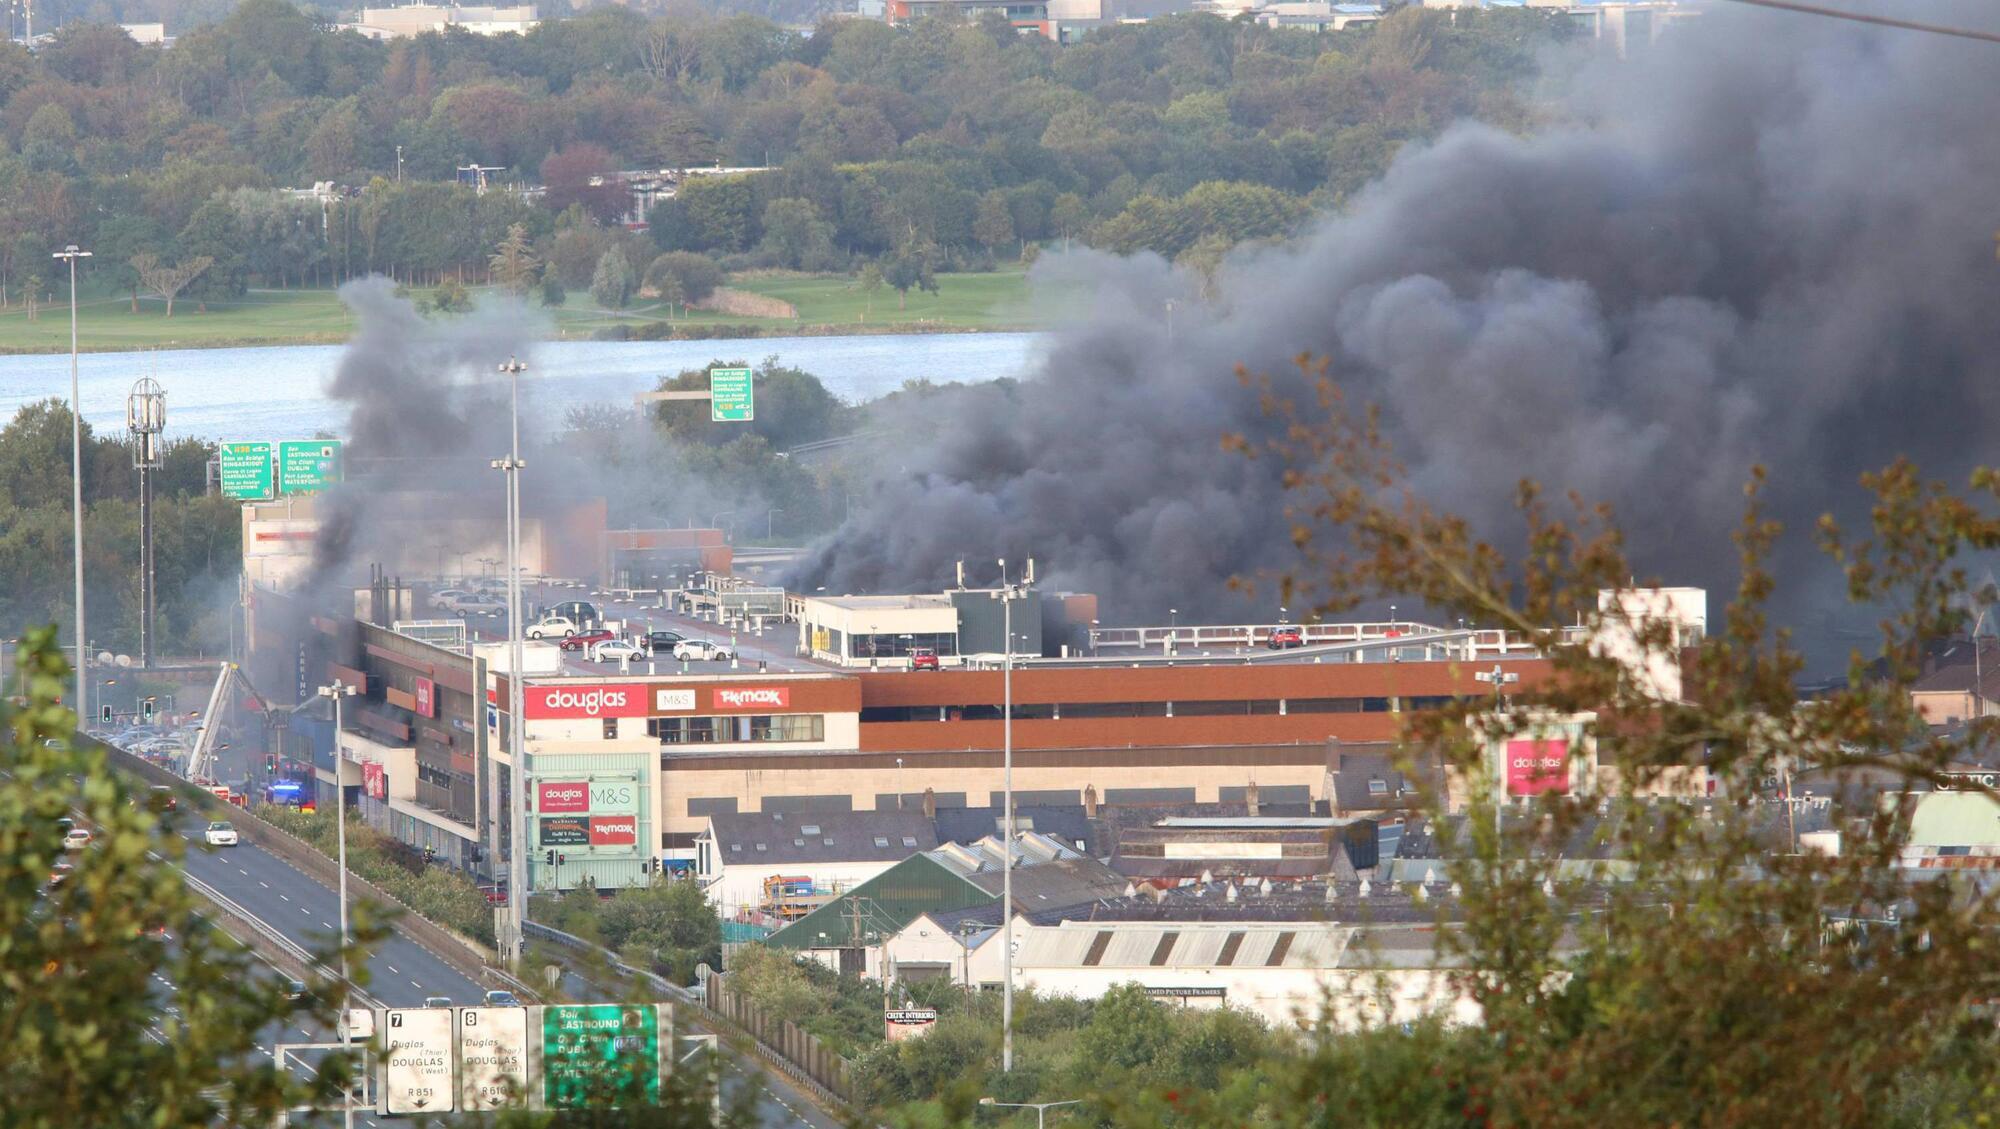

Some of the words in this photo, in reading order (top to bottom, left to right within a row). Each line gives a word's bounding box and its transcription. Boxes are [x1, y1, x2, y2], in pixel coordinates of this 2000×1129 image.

[545, 689, 627, 715] douglas
[663, 695, 689, 706] M&S
[545, 789, 582, 801] douglas
[590, 788, 631, 805] M&S
[392, 1014, 402, 1027] 7
[466, 1012, 476, 1026] 8
[391, 1040, 424, 1049] Duglas
[465, 1038, 498, 1048] Duglas
[392, 1058, 443, 1067] DOUGLAS
[466, 1056, 518, 1065] DOUGLAS
